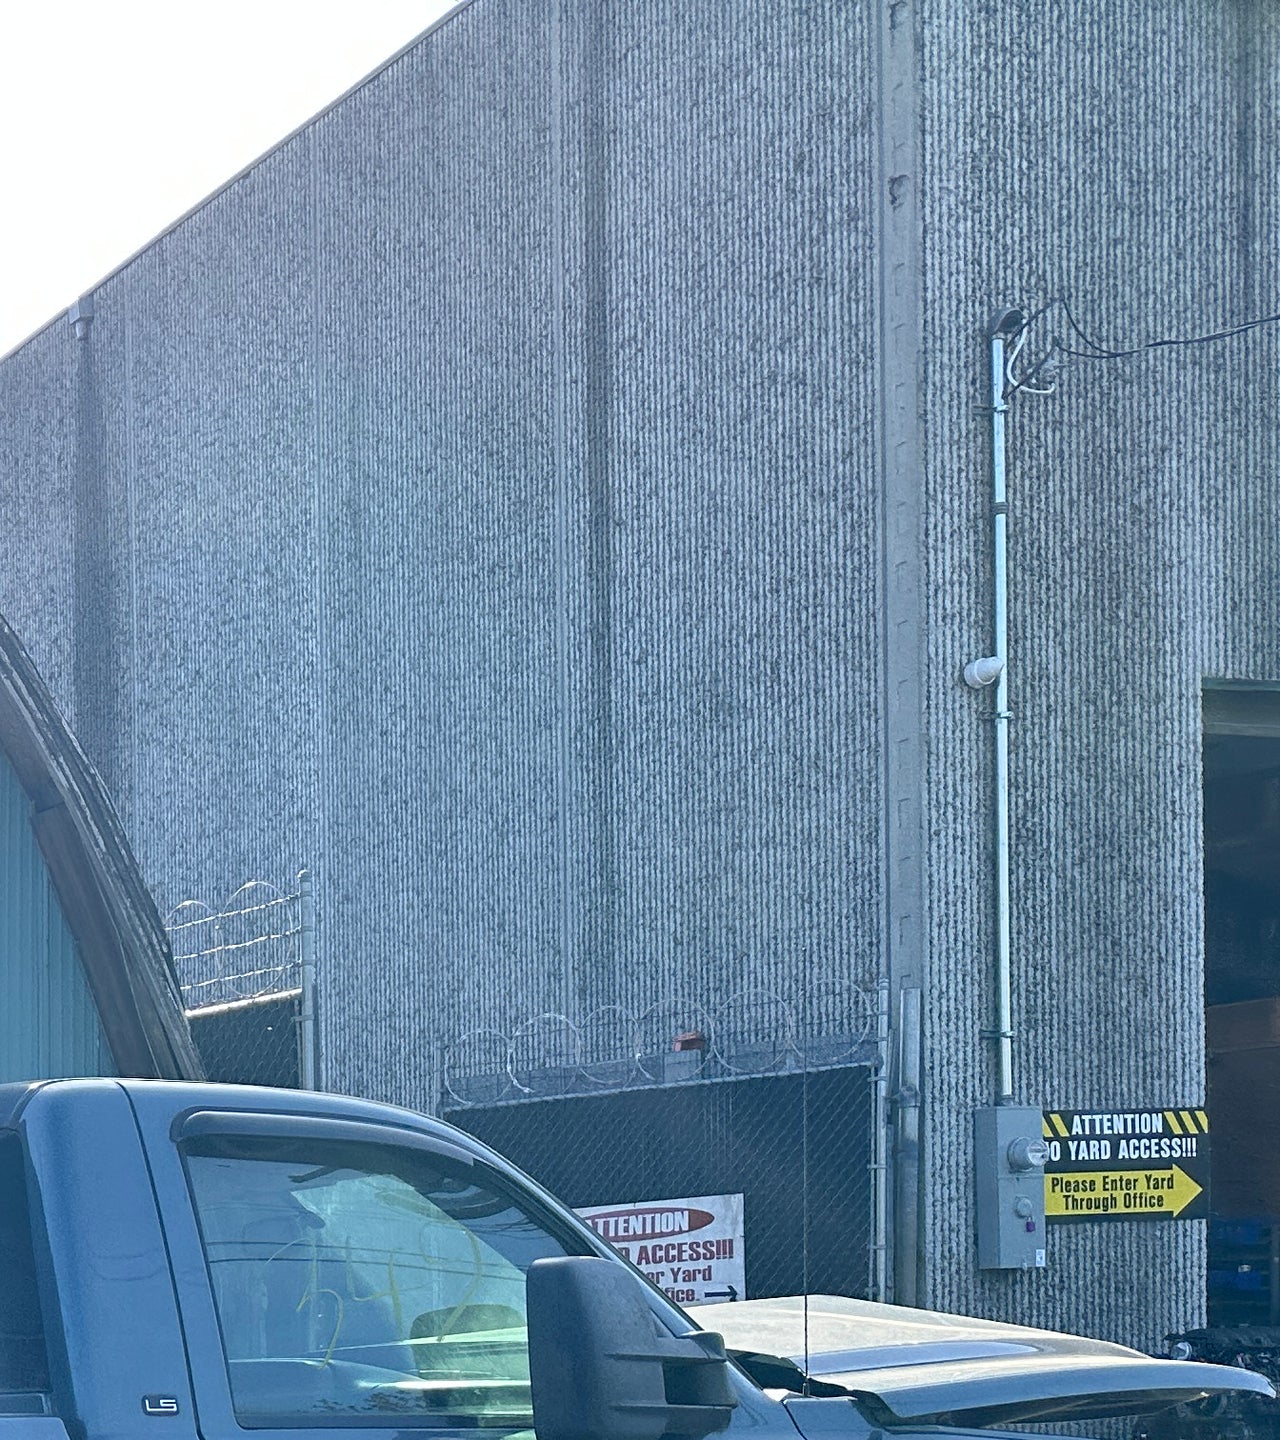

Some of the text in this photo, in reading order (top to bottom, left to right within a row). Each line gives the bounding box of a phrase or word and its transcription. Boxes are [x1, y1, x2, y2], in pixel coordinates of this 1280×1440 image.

[1071, 1112, 1163, 1135] ATTENTION
[1068, 1139, 1111, 1161] YARD
[1118, 1137, 1197, 1159] ACCESS!!!
[1051, 1173, 1174, 1193] Please Enter Yard
[1062, 1192, 1164, 1212] Through Office
[636, 1239, 734, 1266] ACCESS!!!
[670, 1265, 713, 1283] Yard
[145, 1399, 178, 1412] LS
